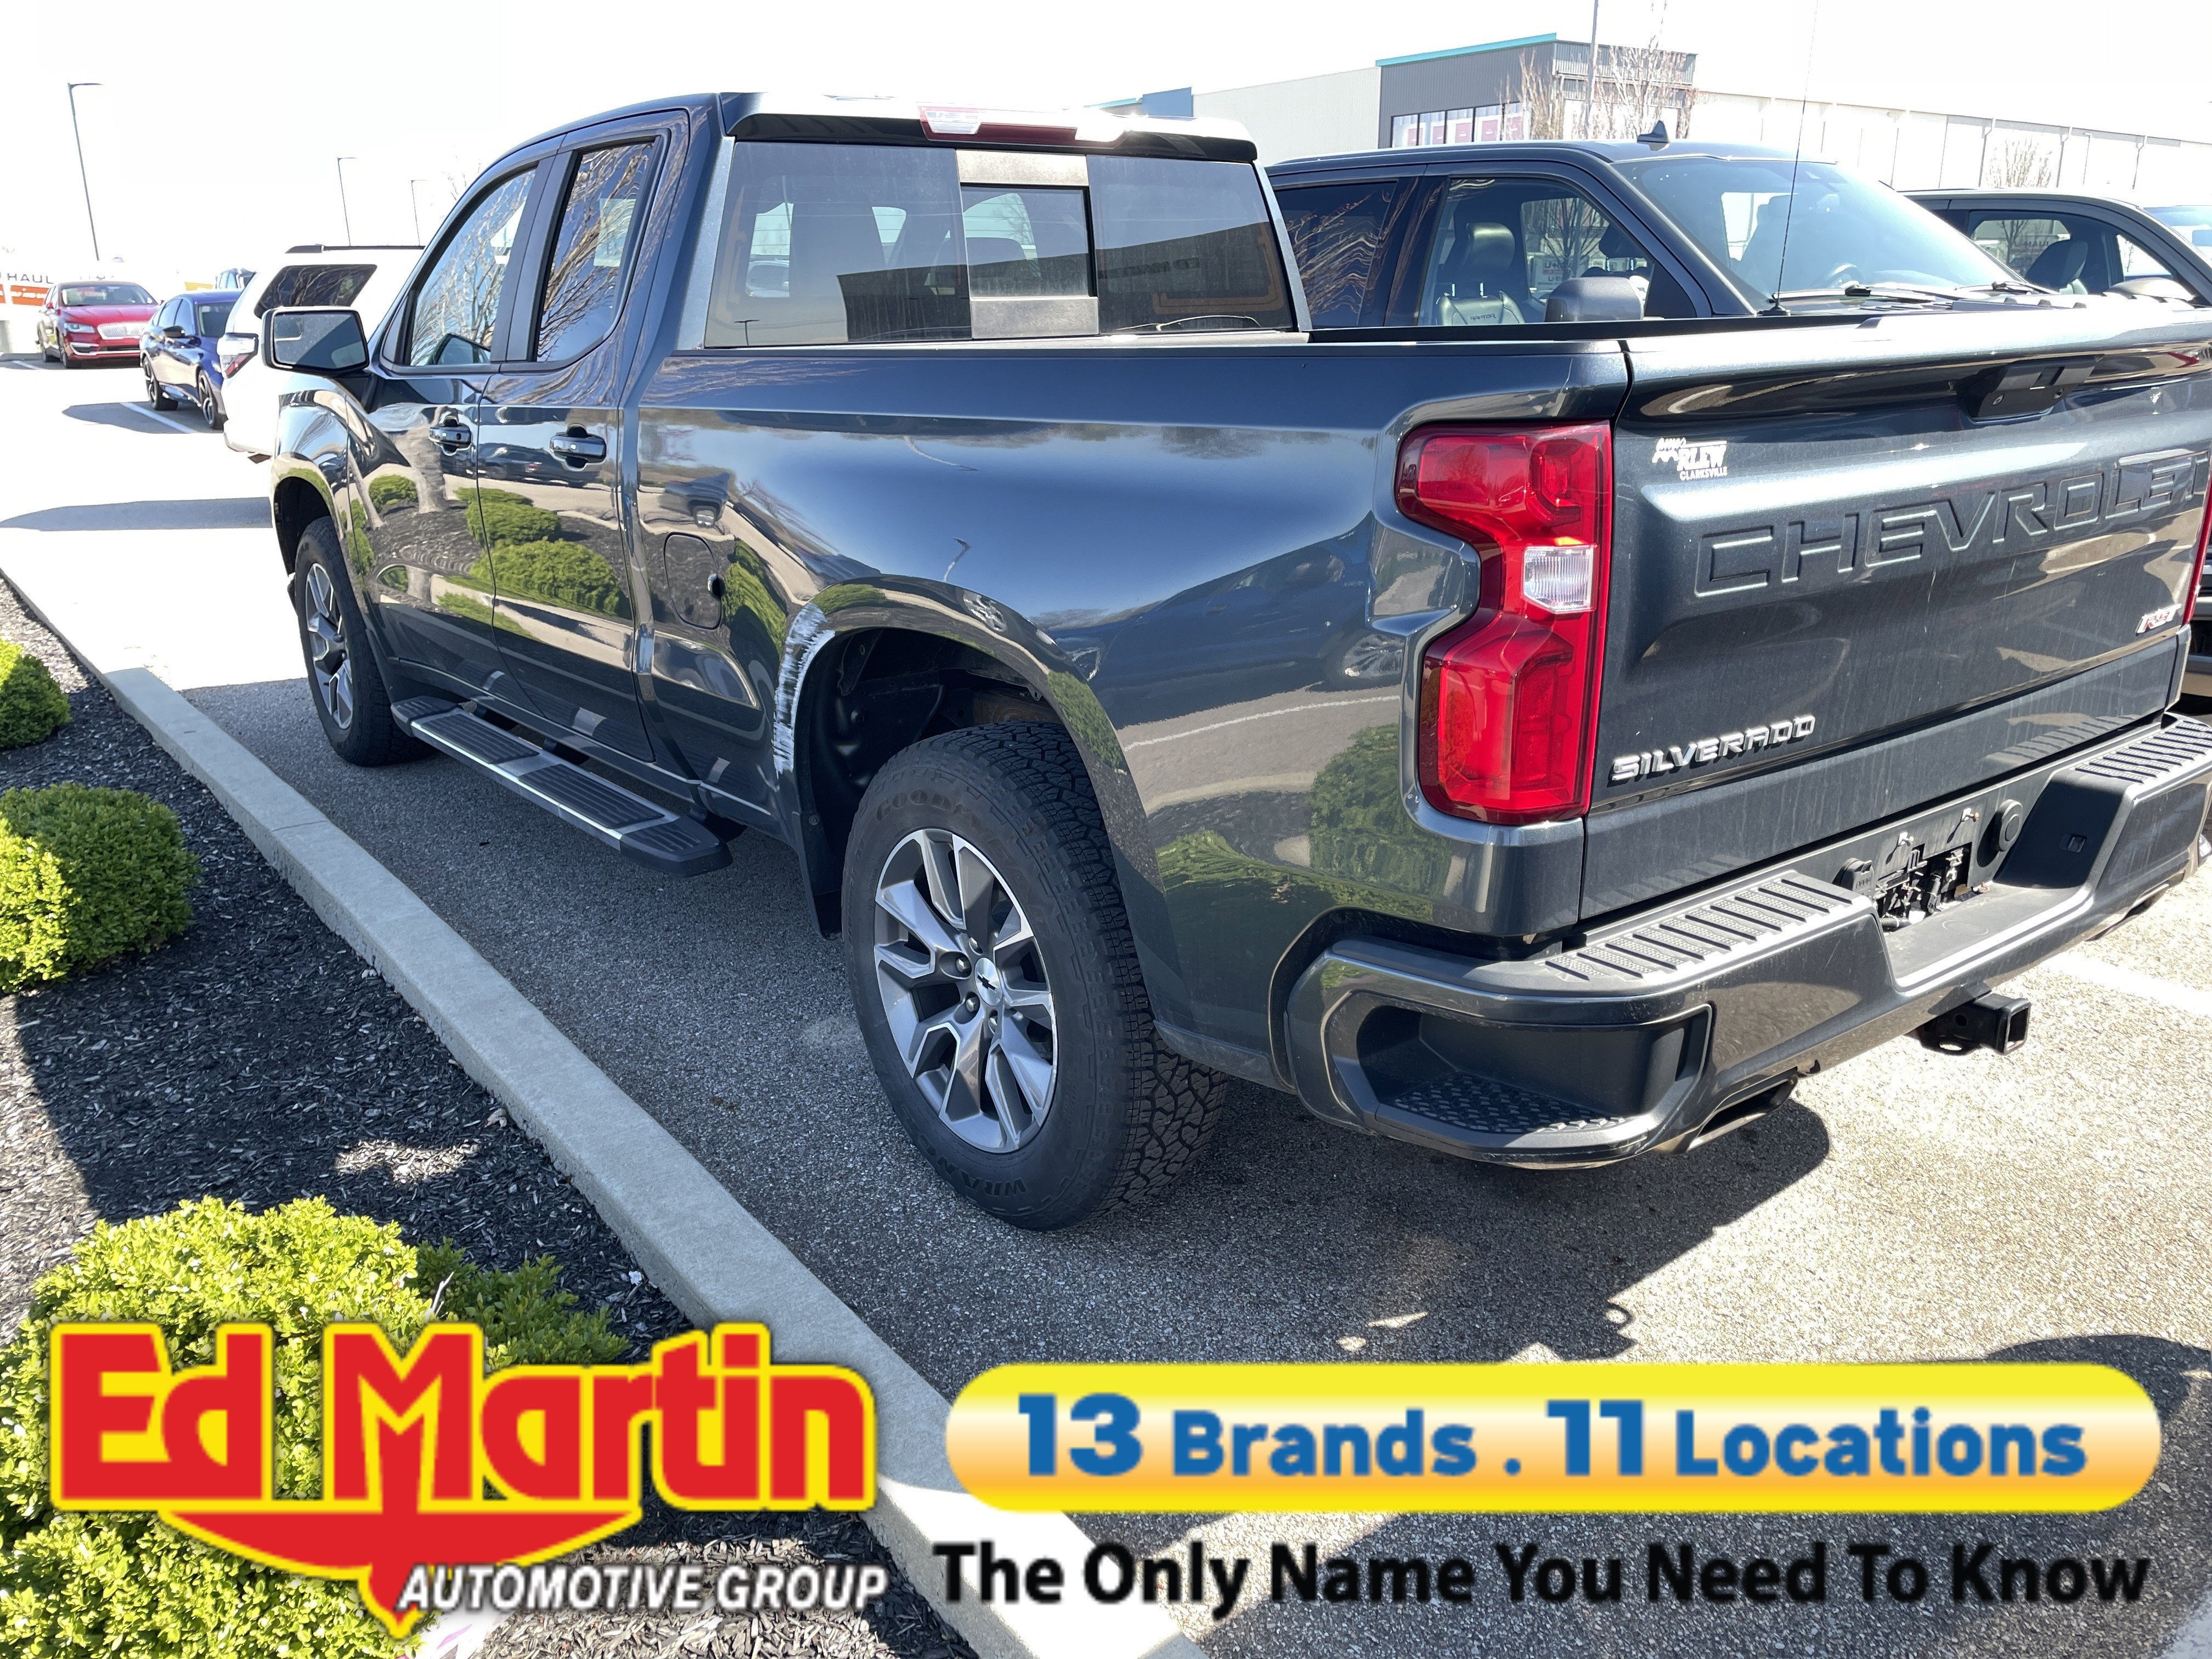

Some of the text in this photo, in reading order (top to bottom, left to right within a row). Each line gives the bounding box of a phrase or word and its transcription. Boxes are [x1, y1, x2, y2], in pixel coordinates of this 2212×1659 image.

[1679, 466, 1728, 481] CLARKSVILLE
[1694, 449, 2209, 598] CHEVROLET
[1611, 714, 1816, 781] SILVERADO
[876, 789, 1051, 938] GOODYEAR
